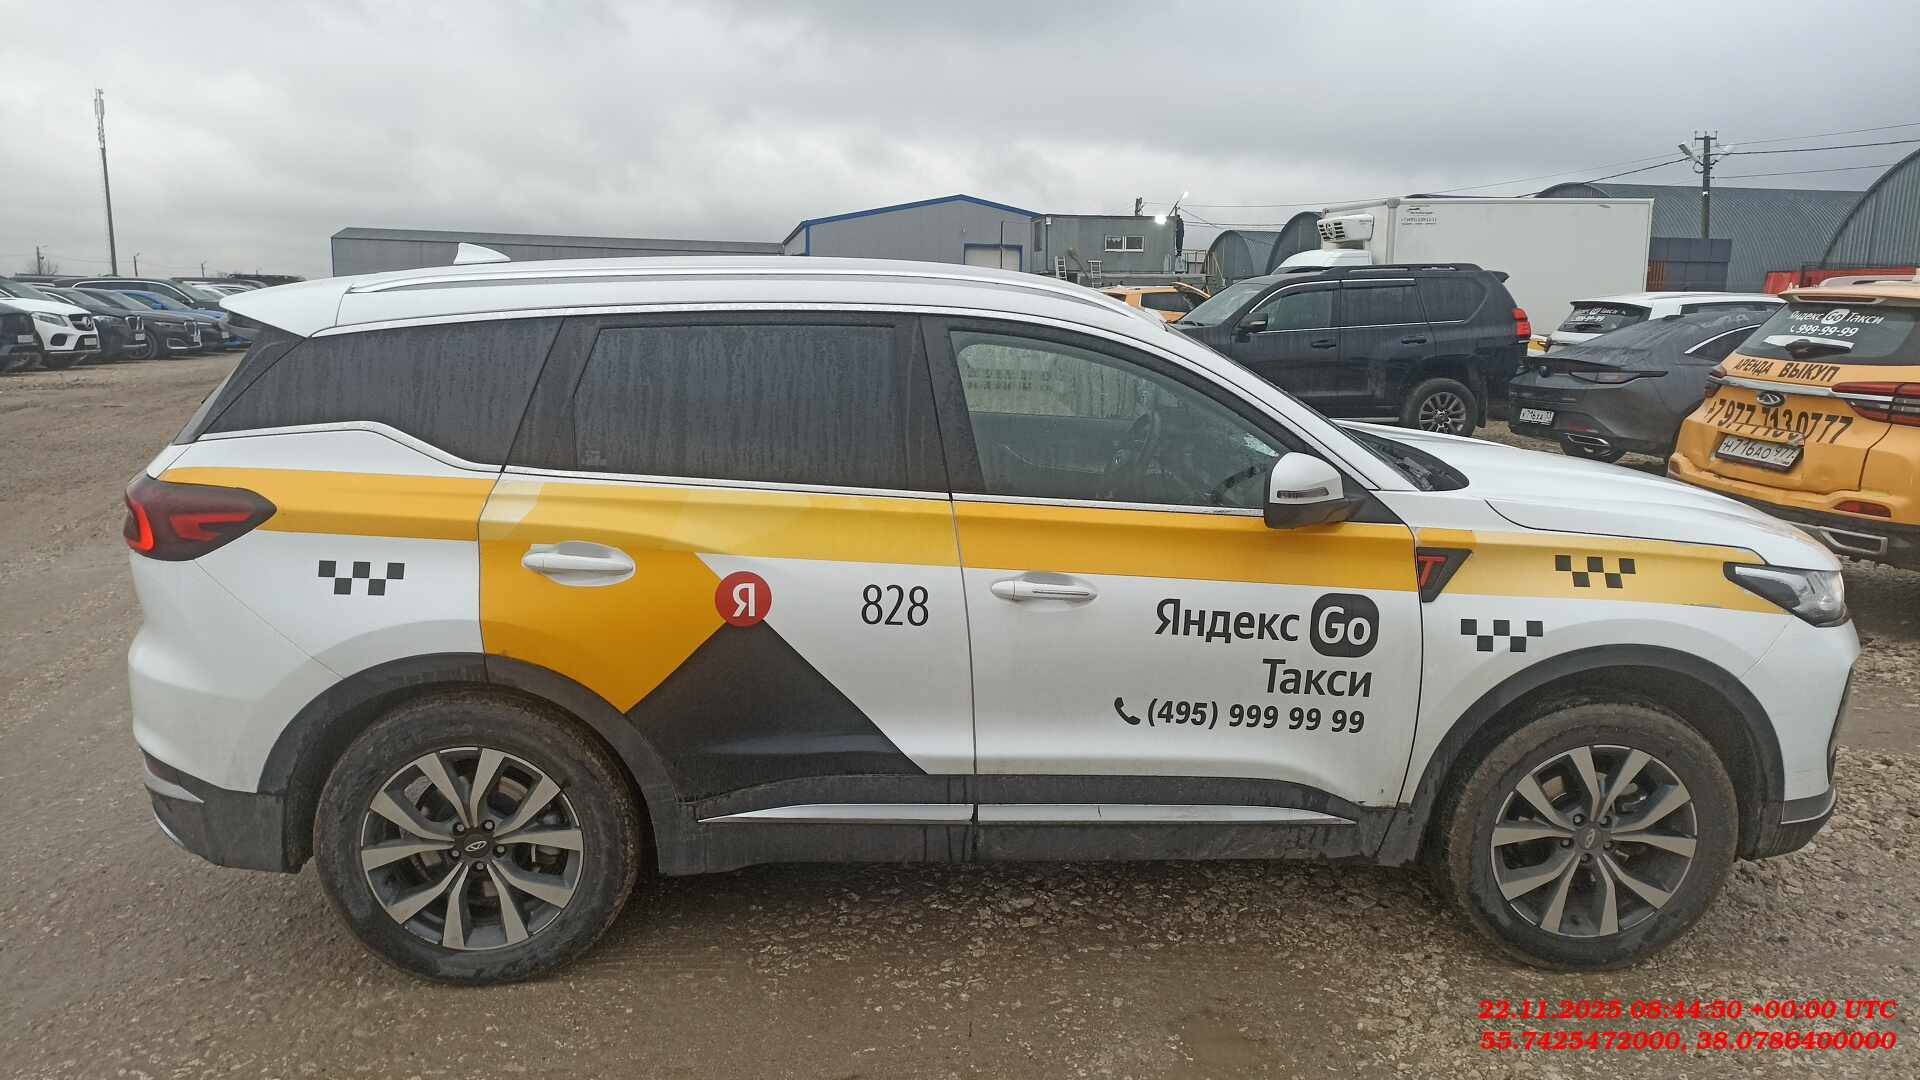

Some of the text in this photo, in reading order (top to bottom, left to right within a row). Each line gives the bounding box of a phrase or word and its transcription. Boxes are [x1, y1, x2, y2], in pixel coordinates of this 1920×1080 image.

[1796, 325, 1859, 337] 999-99-99
[1846, 312, 1886, 325] Такси
[1734, 358, 1841, 382] АРЕНДА ВЫКУП
[732, 582, 756, 617] Я
[861, 583, 930, 627] 828
[1154, 598, 1300, 644] Яндекс
[1262, 658, 1373, 698] Такси
[1147, 698, 1366, 734] (495) 999 99 99
